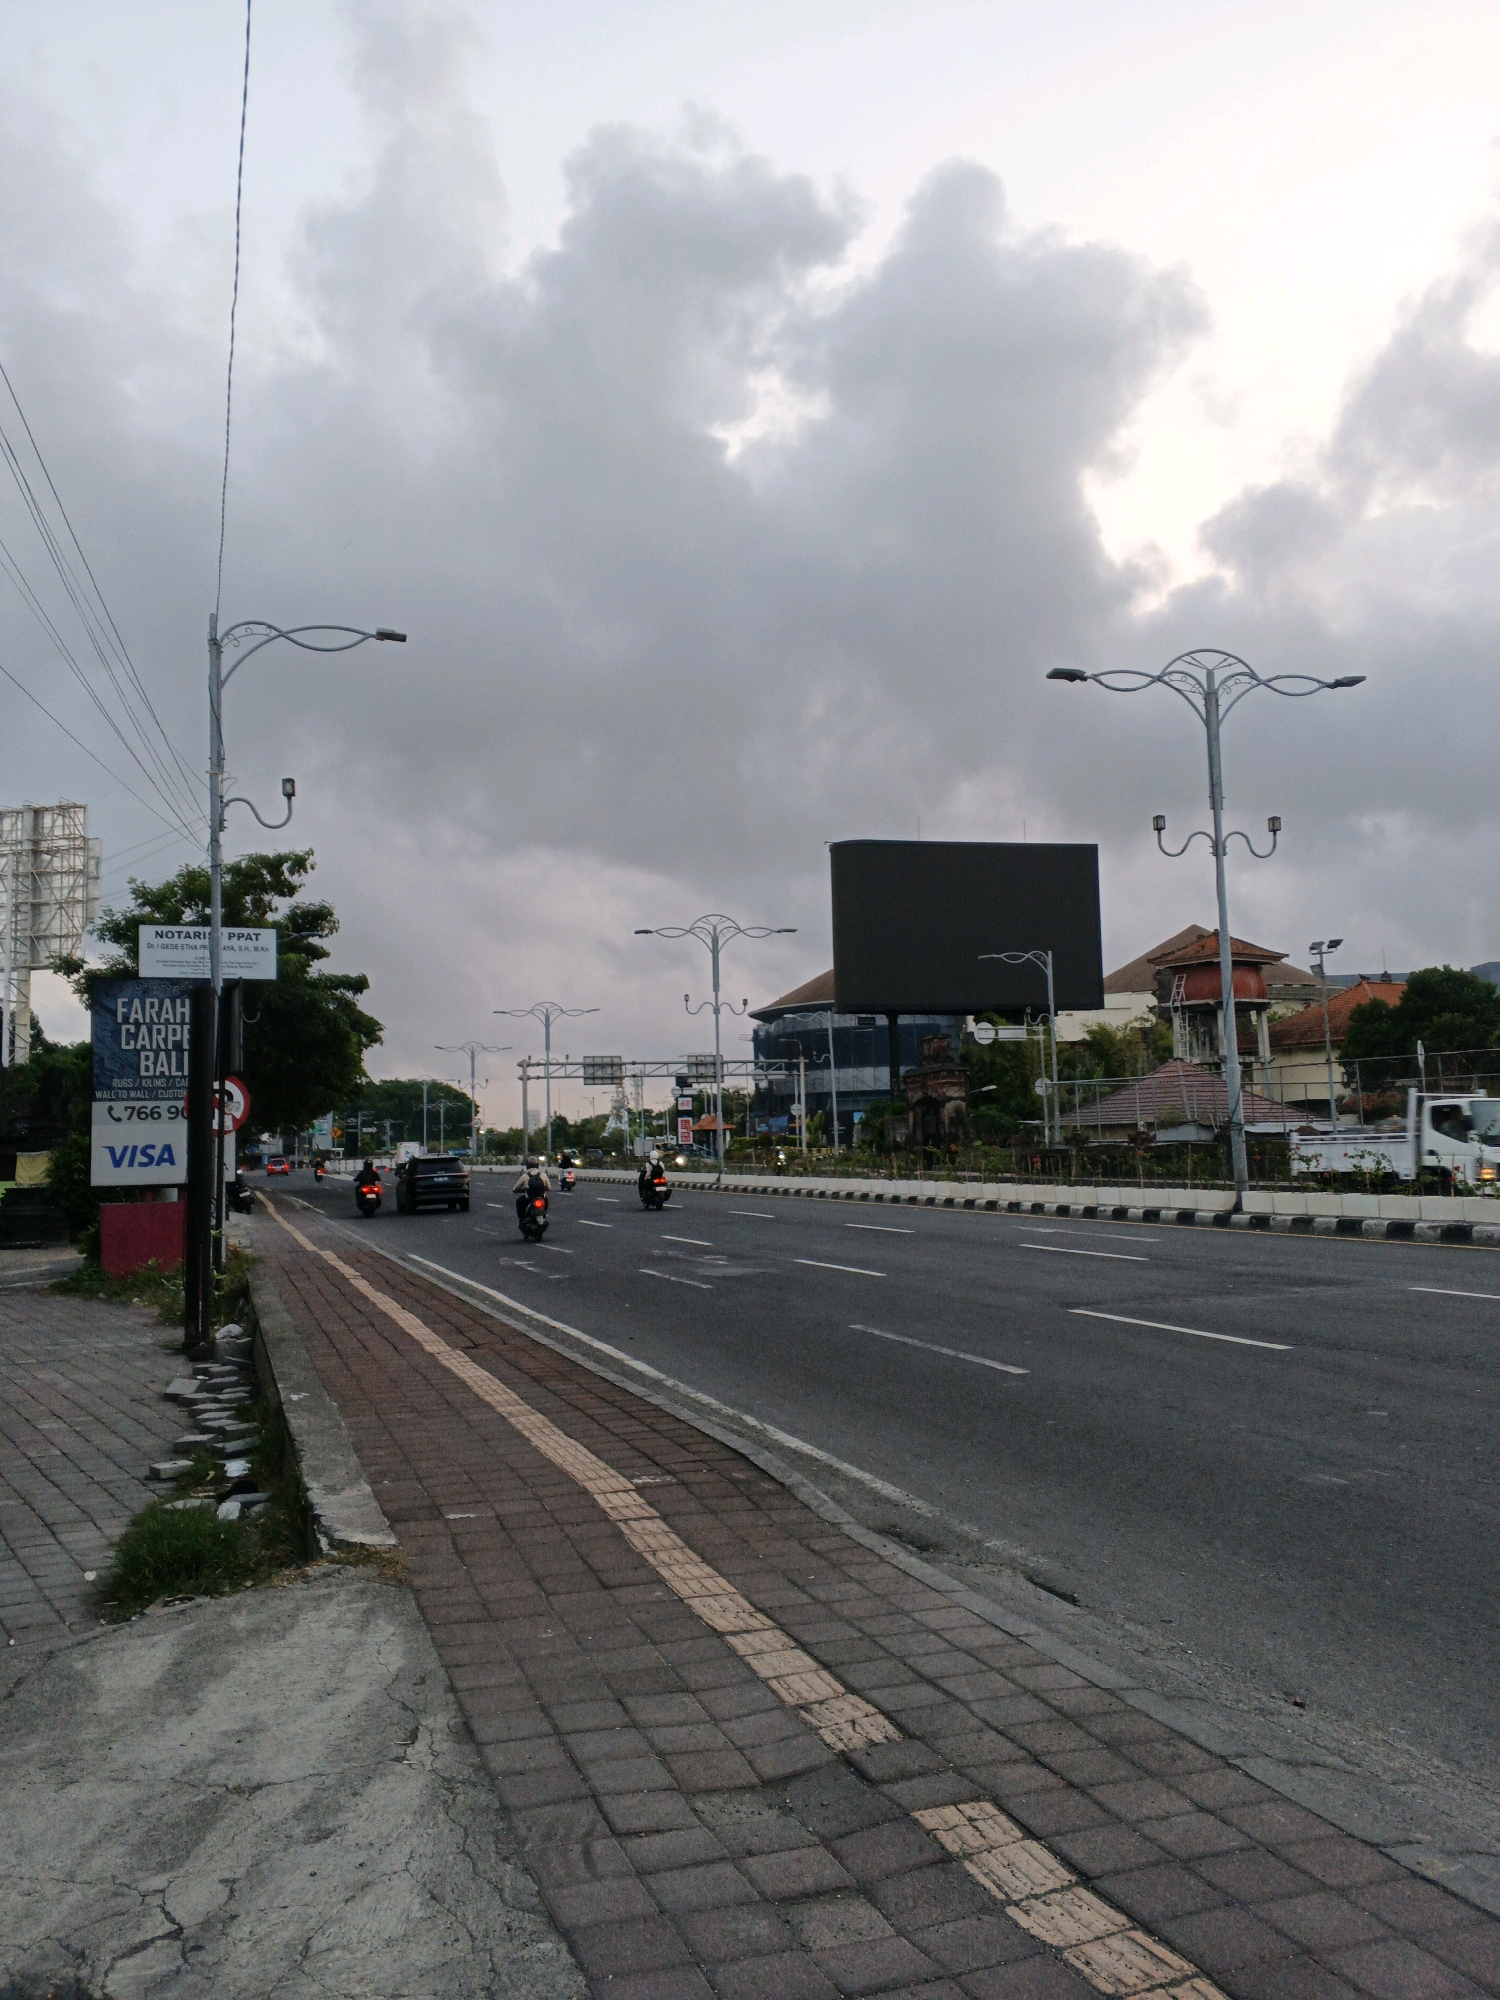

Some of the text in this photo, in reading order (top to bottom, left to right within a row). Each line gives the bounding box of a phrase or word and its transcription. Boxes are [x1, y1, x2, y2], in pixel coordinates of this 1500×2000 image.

[228, 932, 261, 942] PPAT
[117, 998, 190, 1024] FARAH
[140, 1050, 189, 1077] BALI
[112, 1078, 133, 1088] RUGS
[95, 1090, 115, 1099] WALL
[118, 1090, 127, 1099] TO
[130, 1090, 149, 1099] WALL
[124, 1105, 162, 1121] 766
[101, 1143, 176, 1168] VISA
